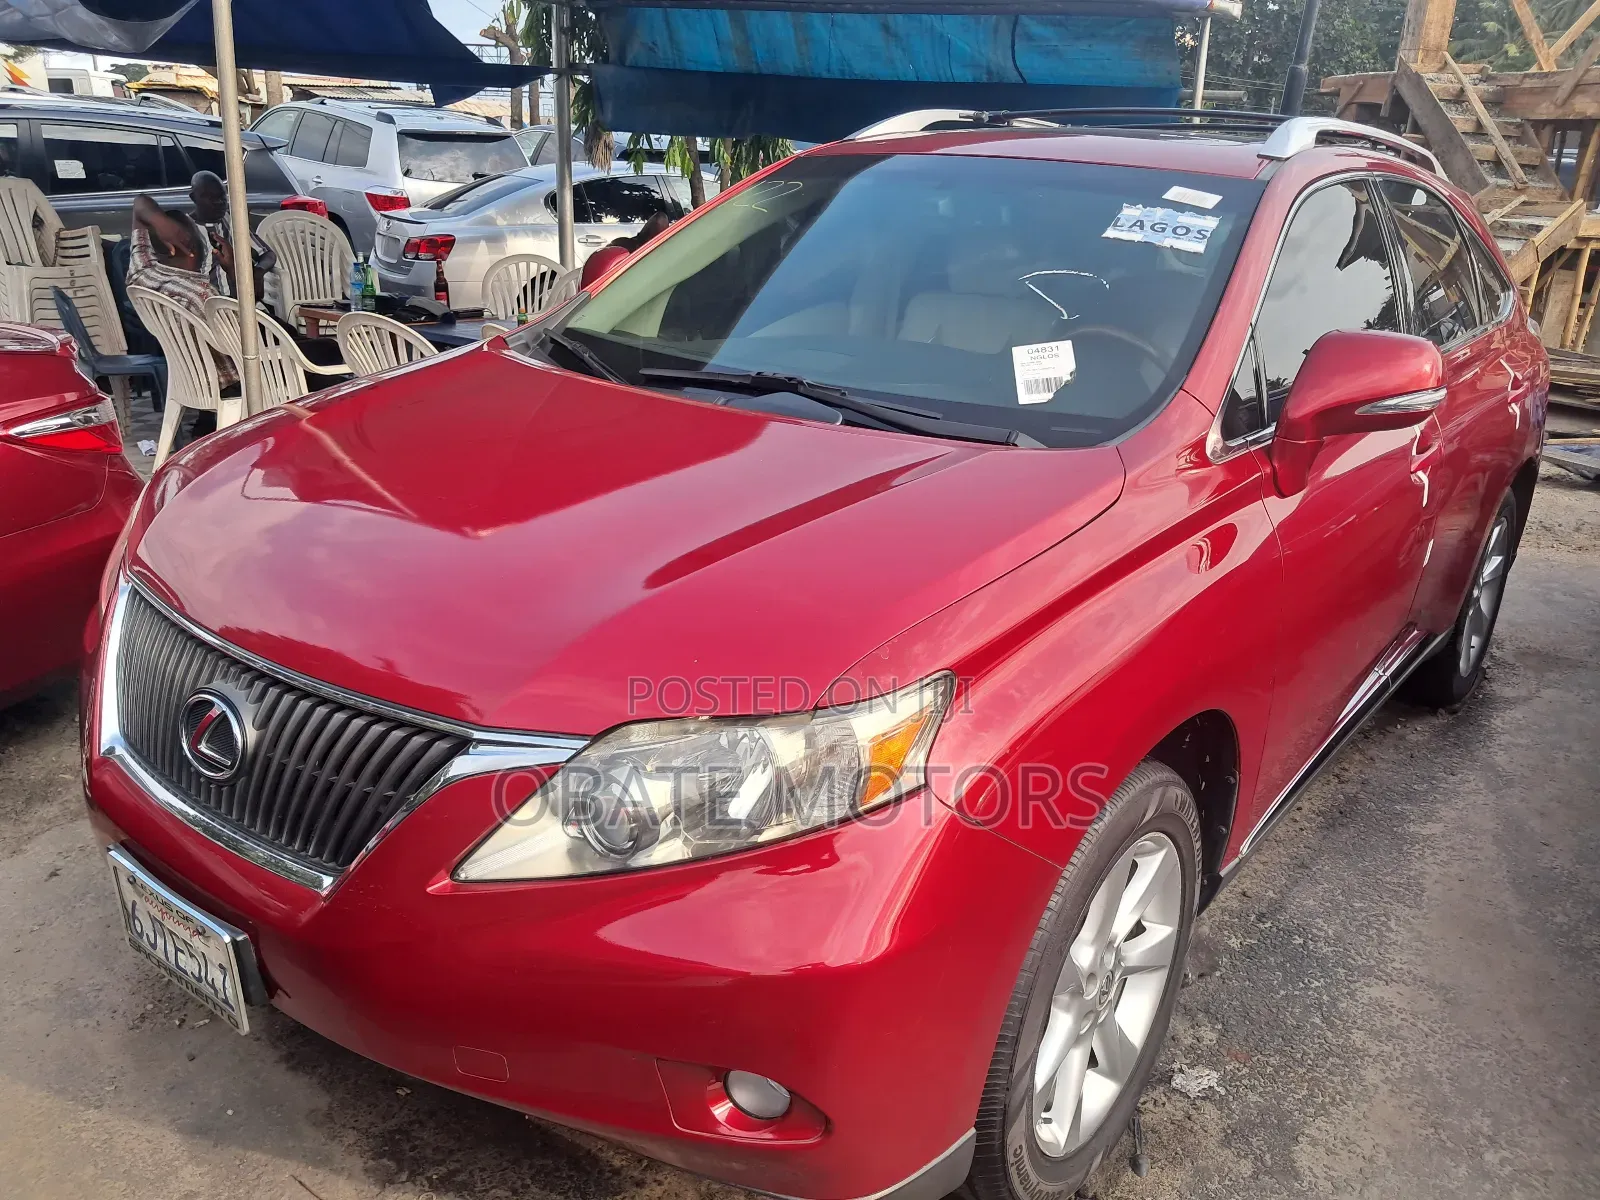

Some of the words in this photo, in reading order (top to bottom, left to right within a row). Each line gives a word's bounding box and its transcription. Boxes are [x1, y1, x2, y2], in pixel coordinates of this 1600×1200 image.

[1112, 217, 1210, 240] LAGOS
[1026, 345, 1060, 355] 04831
[175, 909, 195, 924] OF
